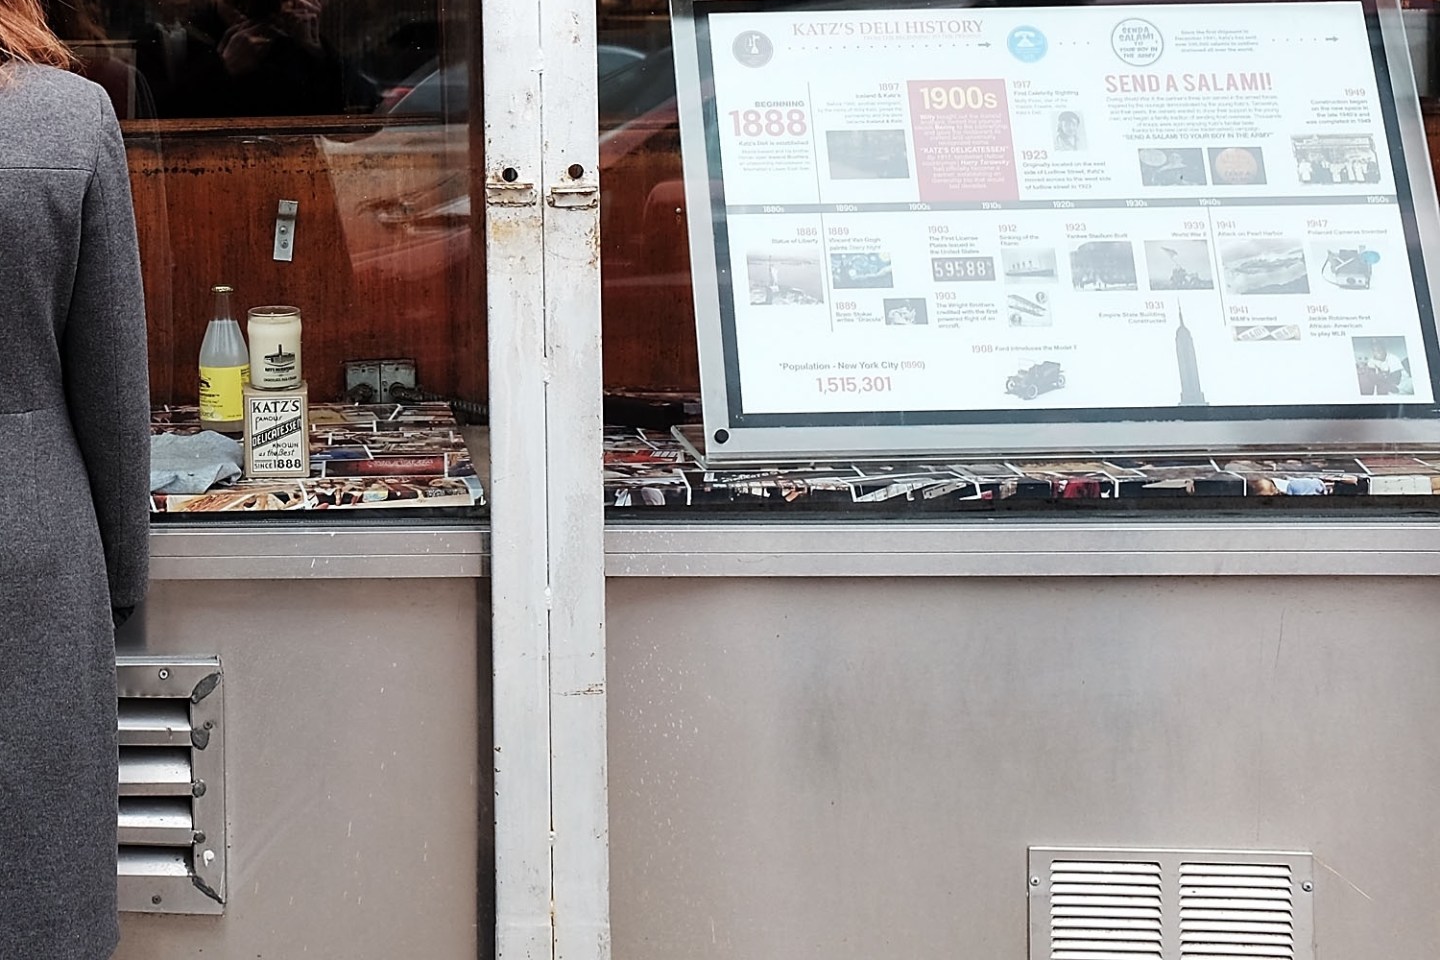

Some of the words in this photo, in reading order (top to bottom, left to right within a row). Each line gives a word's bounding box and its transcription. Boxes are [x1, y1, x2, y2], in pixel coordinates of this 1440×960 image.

[793, 22, 854, 36] KATZ'S
[859, 21, 902, 35] DELI
[906, 20, 983, 33] HISTORY
[879, 83, 899, 91] 1897
[1013, 81, 1031, 89] 1917
[1105, 74, 1160, 93] SEND
[1166, 73, 1179, 92] A
[1183, 72, 1273, 92] SALAMI!
[919, 86, 998, 110] 1900s
[728, 109, 807, 137] 1888
[1021, 150, 1048, 160] 1923
[998, 224, 1017, 232] 1912
[1065, 224, 1087, 232] 1923
[1184, 222, 1205, 230] 1939
[1306, 219, 1328, 228] 1947
[928, 226, 949, 234] 1903
[934, 260, 986, 278] 59588
[935, 292, 956, 300] 1903
[1145, 301, 1164, 310] 1931
[1229, 306, 1248, 314] 1941
[1307, 305, 1329, 313] 1946
[971, 345, 993, 353] 1908
[838, 362, 857, 370] New
[859, 361, 879, 370] York
[881, 361, 899, 371] City
[901, 361, 926, 370] (1890)
[816, 376, 893, 394] 1,515,301
[252, 400, 300, 414] KATZ'S
[273, 458, 302, 469] 1888
